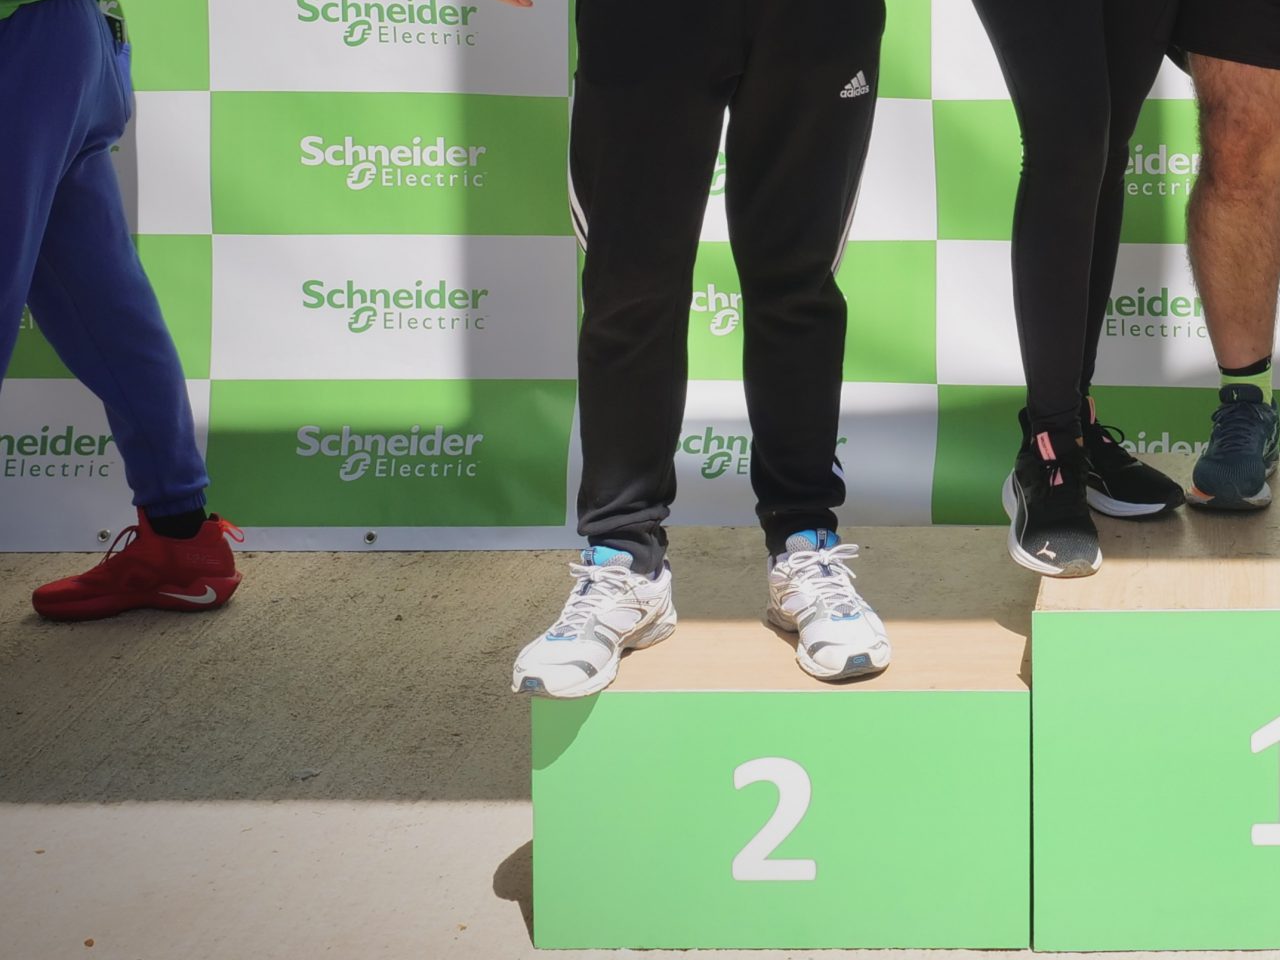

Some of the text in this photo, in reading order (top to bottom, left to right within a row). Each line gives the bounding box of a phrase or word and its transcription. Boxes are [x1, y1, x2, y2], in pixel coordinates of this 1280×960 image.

[379, 27, 476, 46] Electric
[840, 85, 869, 98] adidas
[300, 136, 486, 166] Schneider
[382, 168, 484, 187] Electric
[1127, 178, 1190, 195] ectri
[302, 280, 488, 309] Schneider
[384, 312, 485, 330] Electric
[1106, 319, 1207, 337] Electric
[0, 426, 113, 456] neider
[296, 425, 483, 456] Schneider
[5, 459, 109, 477] Electric
[376, 458, 477, 478] Electric
[732, 757, 817, 881] 2
